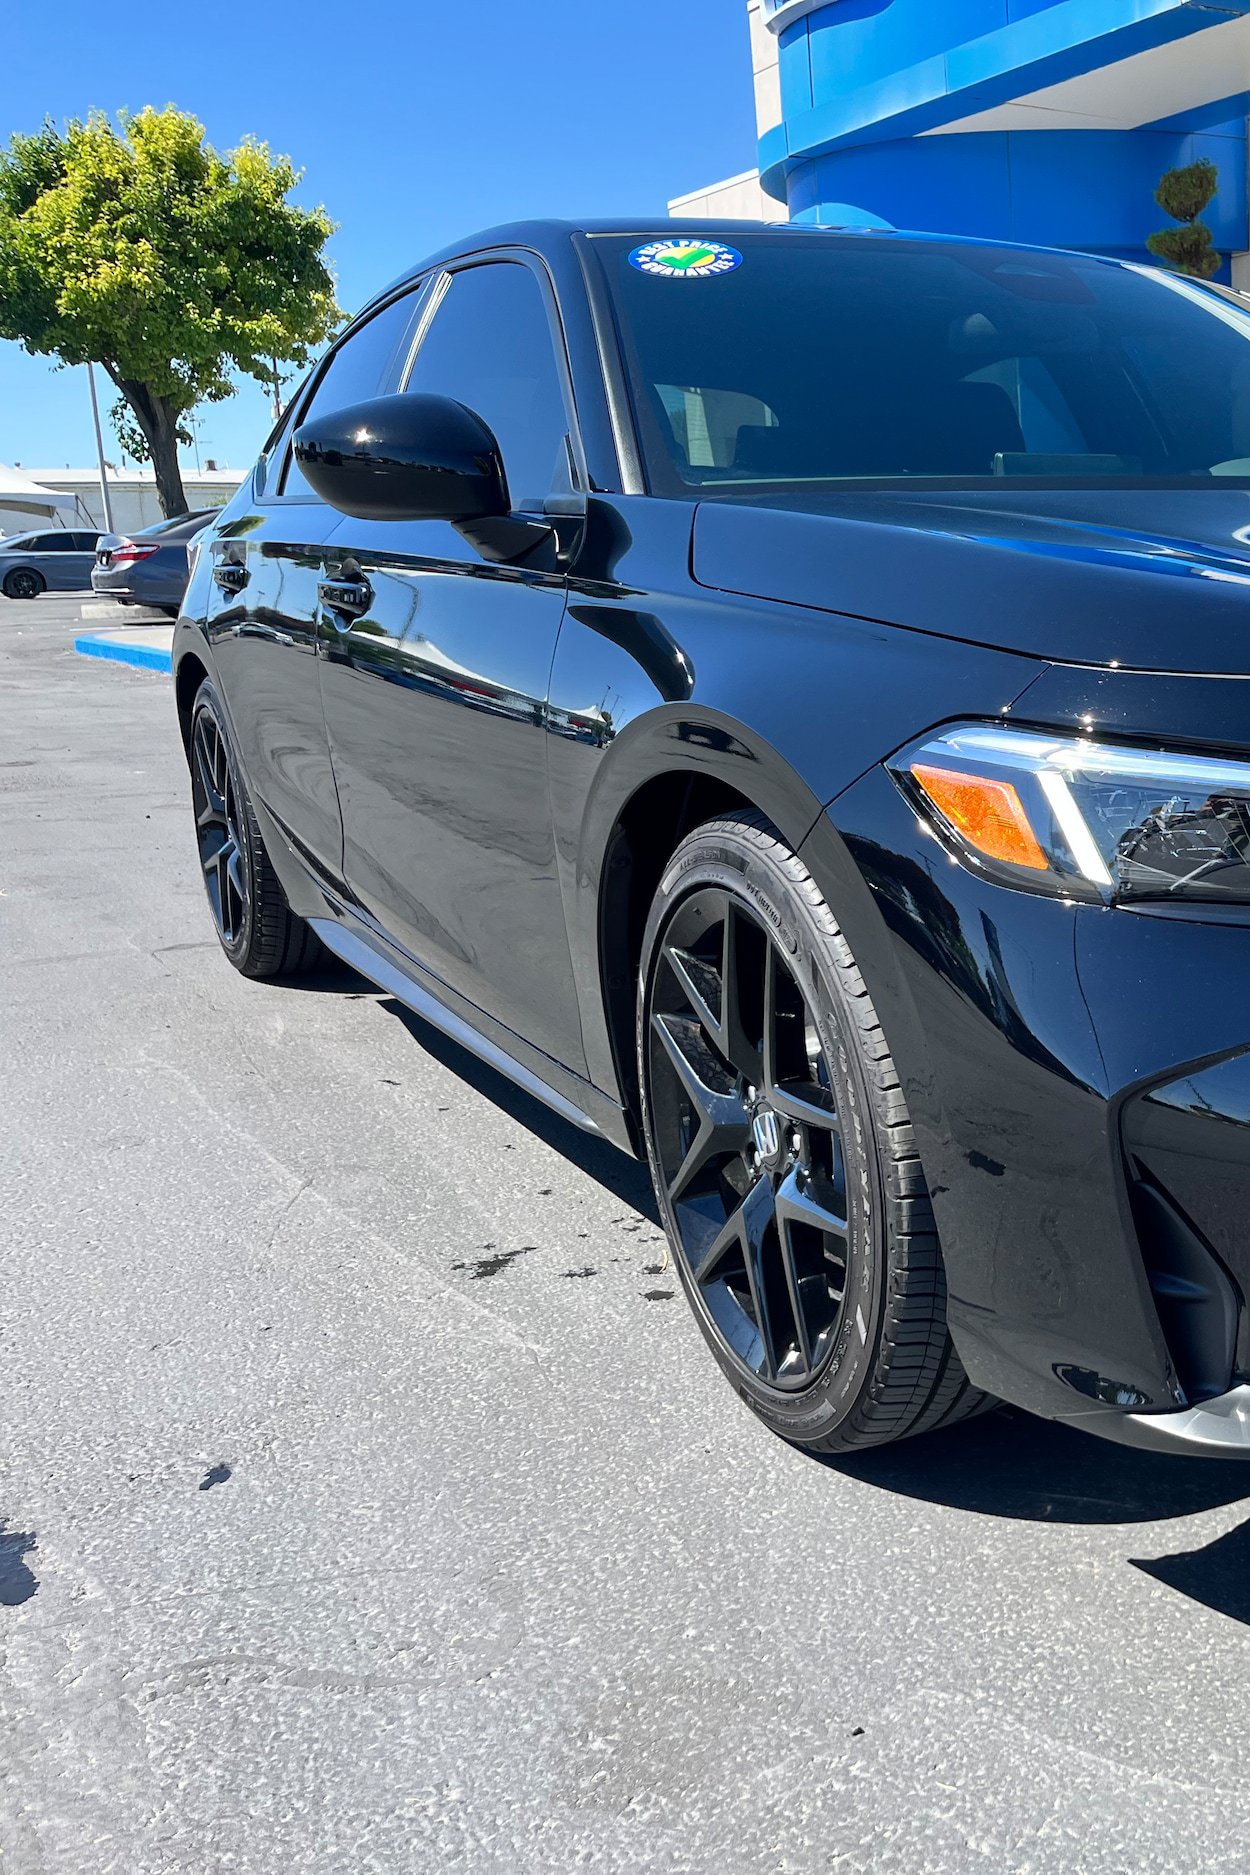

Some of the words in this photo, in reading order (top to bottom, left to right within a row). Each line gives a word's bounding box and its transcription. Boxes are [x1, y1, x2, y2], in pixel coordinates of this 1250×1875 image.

[638, 241, 675, 256] BEST
[679, 240, 729, 254] PRICE
[641, 260, 735, 277] GUARANTEE
